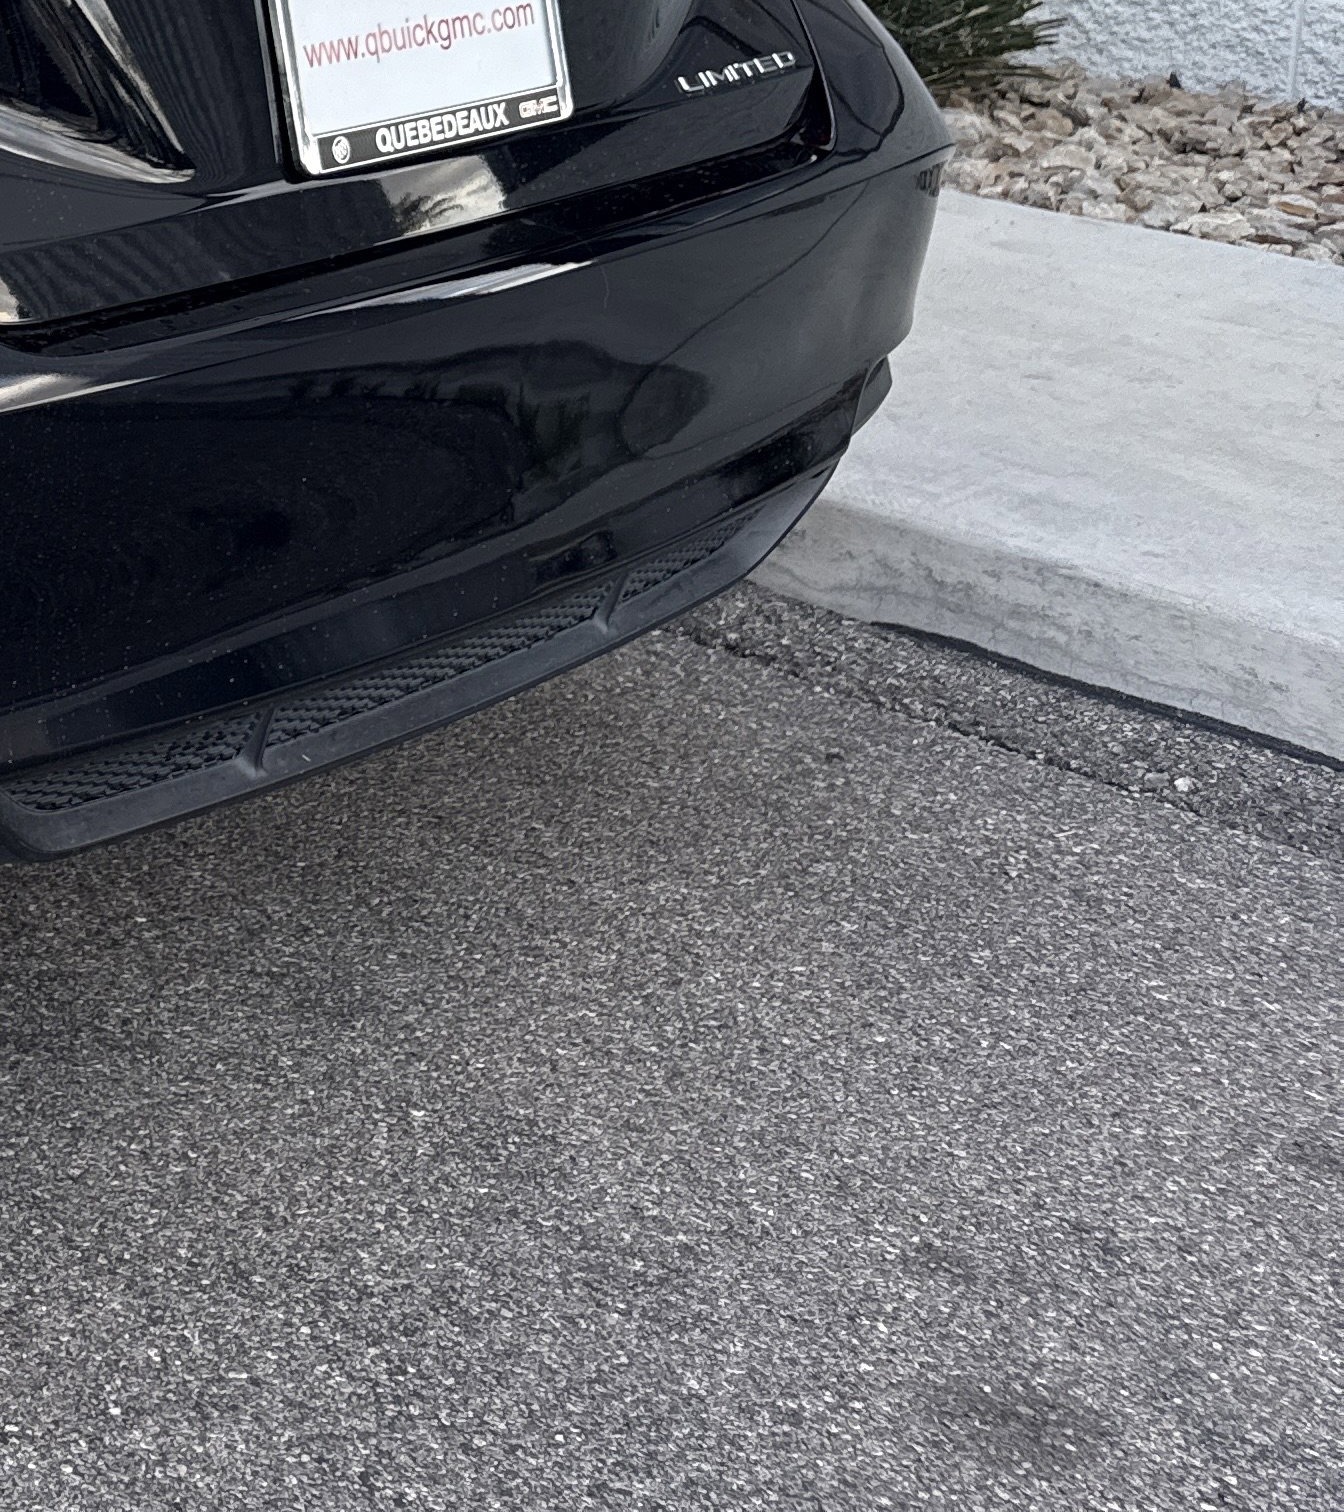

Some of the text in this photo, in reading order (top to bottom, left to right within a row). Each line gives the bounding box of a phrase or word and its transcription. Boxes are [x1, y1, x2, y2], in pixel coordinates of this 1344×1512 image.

[302, 1, 535, 68] www.qbuickgmc.com
[676, 50, 796, 94] LIMITED
[375, 94, 558, 154] QUEBEDEAUX GMC
